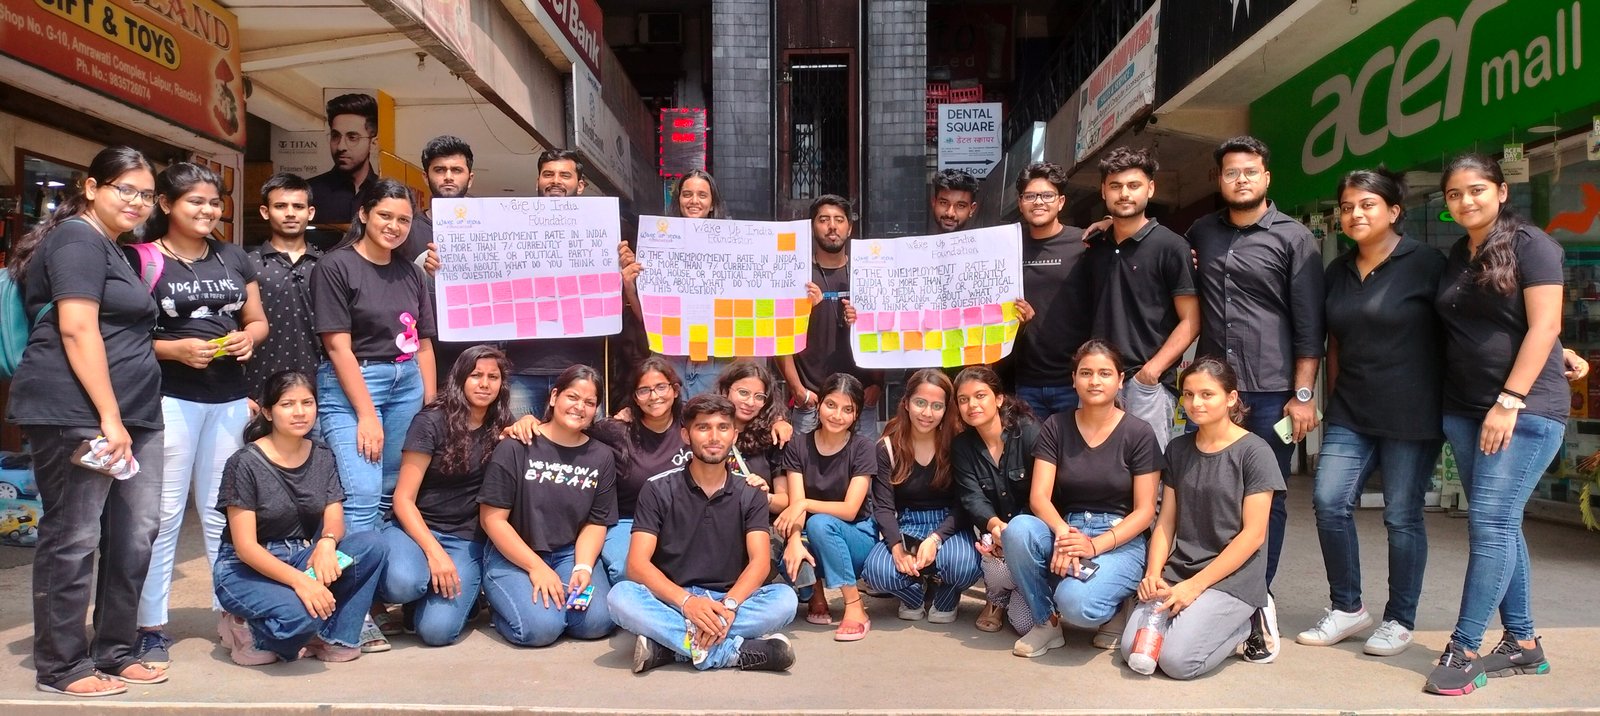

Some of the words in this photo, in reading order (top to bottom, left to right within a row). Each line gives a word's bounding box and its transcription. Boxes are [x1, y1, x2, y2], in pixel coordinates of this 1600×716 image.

[40, 0, 94, 24] FT
[102, 6, 118, 37] &
[124, 16, 176, 65] TOYS
[133, 0, 231, 51] AND
[569, 0, 600, 69] Bank
[0, 3, 25, 31] Shop
[27, 16, 44, 37] No.
[72, 37, 111, 66] Amrawati
[112, 55, 149, 84] Complex,
[76, 58, 90, 75] Ph.
[1302, 0, 1504, 175] acer
[1481, 1, 1582, 106] mall
[948, 108, 993, 119] DENTAL
[946, 121, 995, 132] SQUARE
[965, 167, 988, 175] Floor
[692, 220, 721, 234] Wake
[448, 233, 466, 243] THE
[469, 231, 538, 242] UNEMPLOYMENT
[545, 230, 565, 240] RATE
[571, 230, 579, 239] IN
[586, 229, 607, 239] INDIA
[950, 234, 976, 246] India
[451, 243, 472, 252] MORE
[476, 242, 497, 251] THAN
[517, 240, 562, 250] CURRENTLY
[568, 239, 584, 248] BUT
[592, 239, 603, 248] NO
[931, 247, 979, 259] Foundation
[440, 253, 467, 263] MEDIA
[473, 252, 500, 262] HOUSE
[506, 251, 517, 261] OR
[568, 249, 593, 258] PARTY
[601, 248, 609, 257] IS
[648, 250, 665, 260] THE
[737, 254, 755, 263] RATE
[761, 254, 769, 263] IN
[776, 254, 797, 263] INDIA
[440, 263, 471, 273] ALKING
[474, 262, 500, 272] ABOUT
[504, 260, 527, 270] WHAT
[532, 260, 541, 269] DO
[547, 259, 562, 268] YOU
[569, 258, 595, 268] THINK
[602, 258, 612, 267] OF
[646, 260, 653, 268] IS
[658, 260, 679, 268] MORE
[683, 261, 702, 270] THAN
[723, 262, 766, 271] CURRENTLY
[773, 262, 789, 271] BUT
[794, 261, 806, 270] NO
[862, 268, 882, 278] THE
[887, 263, 956, 278] UNEMPLOYMENT
[965, 260, 989, 273] RATE
[994, 258, 1005, 271] IN
[442, 272, 458, 281] THIS
[462, 270, 502, 280] QUESTION
[667, 269, 692, 278] HOUSE
[696, 270, 706, 278] OR
[753, 270, 776, 279] PARTY
[785, 270, 793, 279] IS
[857, 278, 882, 288] INDIA
[888, 278, 895, 287] IS
[899, 277, 918, 287] MORE
[922, 275, 942, 287] THAN
[958, 268, 1006, 281] CURRENTLY
[168, 280, 201, 295] YOGA
[201, 279, 239, 292] TIME
[653, 284, 672, 293] THIS
[677, 285, 717, 295] QUESTION
[673, 277, 696, 287] ABOUT
[702, 279, 726, 288] WHAT
[733, 279, 742, 288] DO
[746, 279, 763, 289] YOU
[770, 279, 796, 288] THINK
[859, 286, 874, 296] BUT
[891, 286, 915, 297] MEDIA
[920, 283, 949, 295] HOUSE
[955, 281, 966, 291] OR
[973, 276, 1014, 289] POLITICAL
[854, 294, 878, 304] PARTY
[883, 295, 890, 303] IS
[894, 293, 929, 303] TALKING
[936, 291, 961, 302] ABOUT
[968, 286, 992, 298] WHAT
[999, 285, 1009, 294] DO
[860, 302, 877, 311] YOU
[882, 302, 908, 311] THINK
[914, 302, 924, 310] OF
[930, 301, 947, 311] THIS
[951, 296, 992, 309] QUESTION
[529, 459, 544, 469] WE
[545, 462, 574, 473] WERE
[574, 466, 589, 475] ON
[589, 469, 599, 478] A
